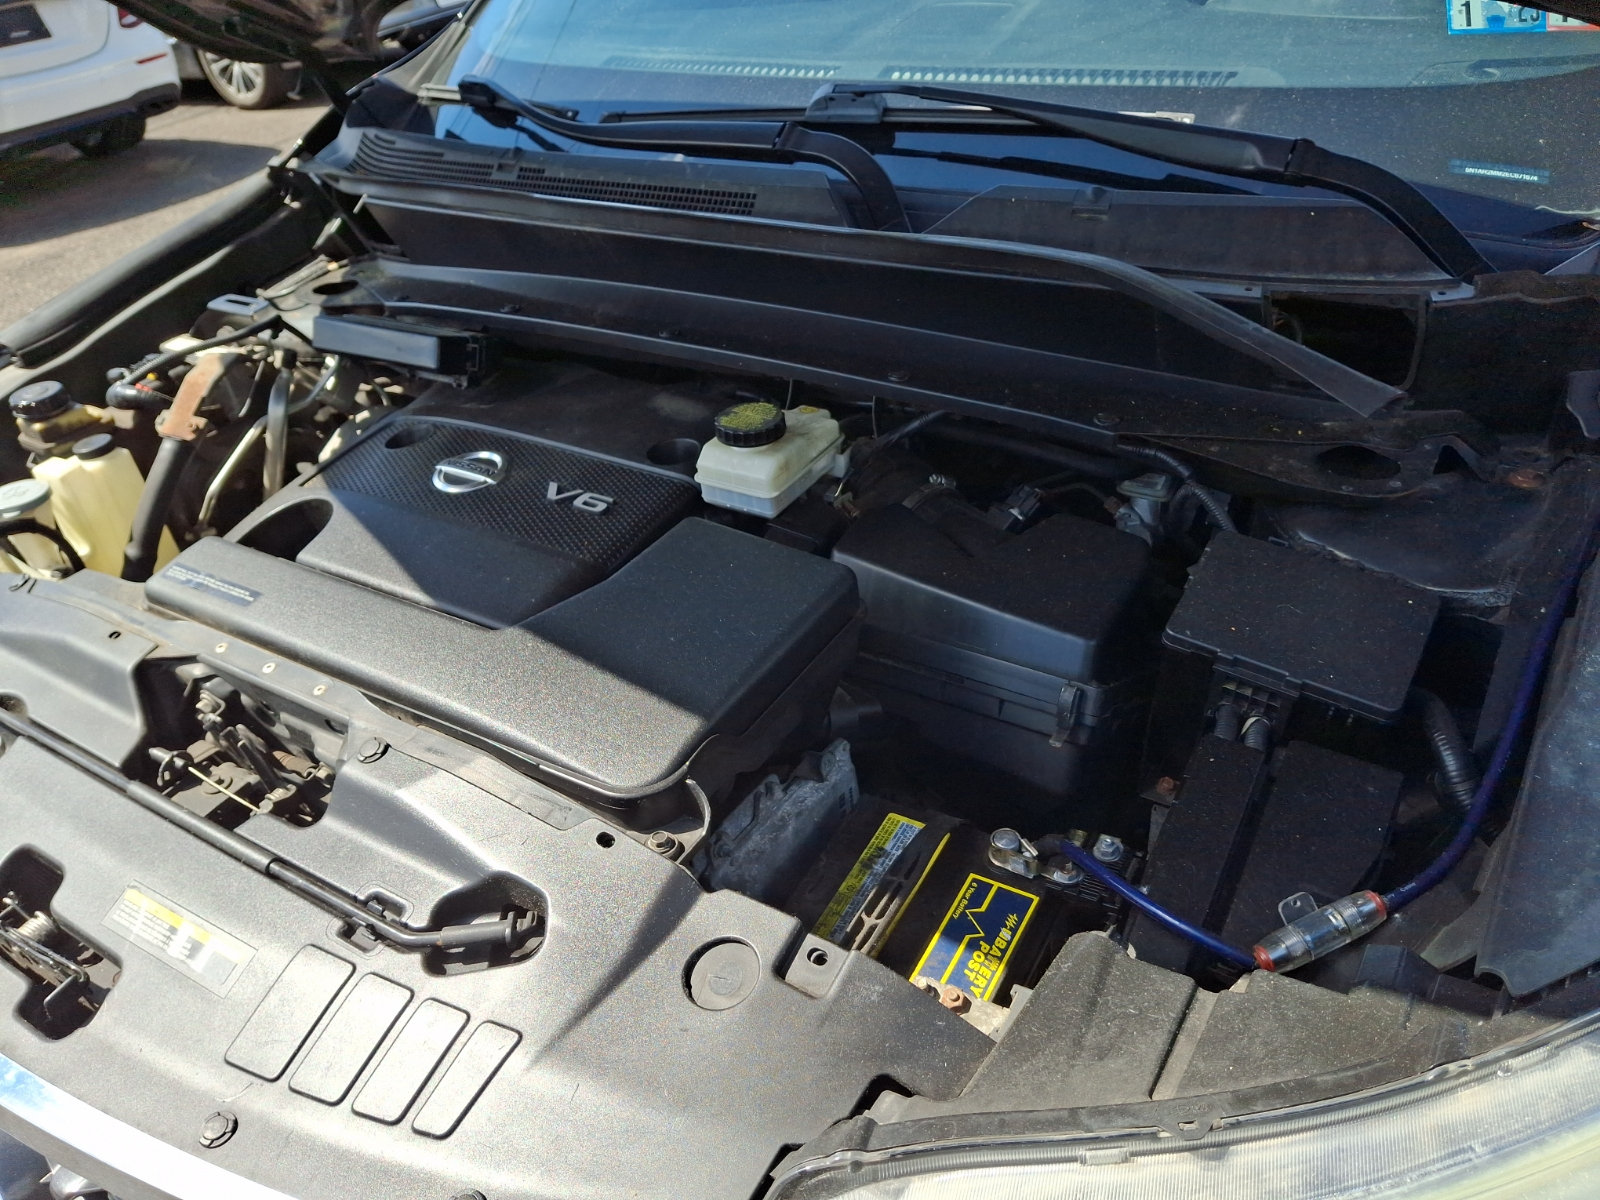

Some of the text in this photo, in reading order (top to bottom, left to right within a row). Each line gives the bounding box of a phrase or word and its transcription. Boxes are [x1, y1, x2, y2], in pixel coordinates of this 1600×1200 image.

[446, 459, 496, 476] NISSAN
[546, 481, 615, 514] V6
[966, 887, 975, 899] Year
[953, 898, 968, 919] Battery
[964, 940, 990, 981] POST
